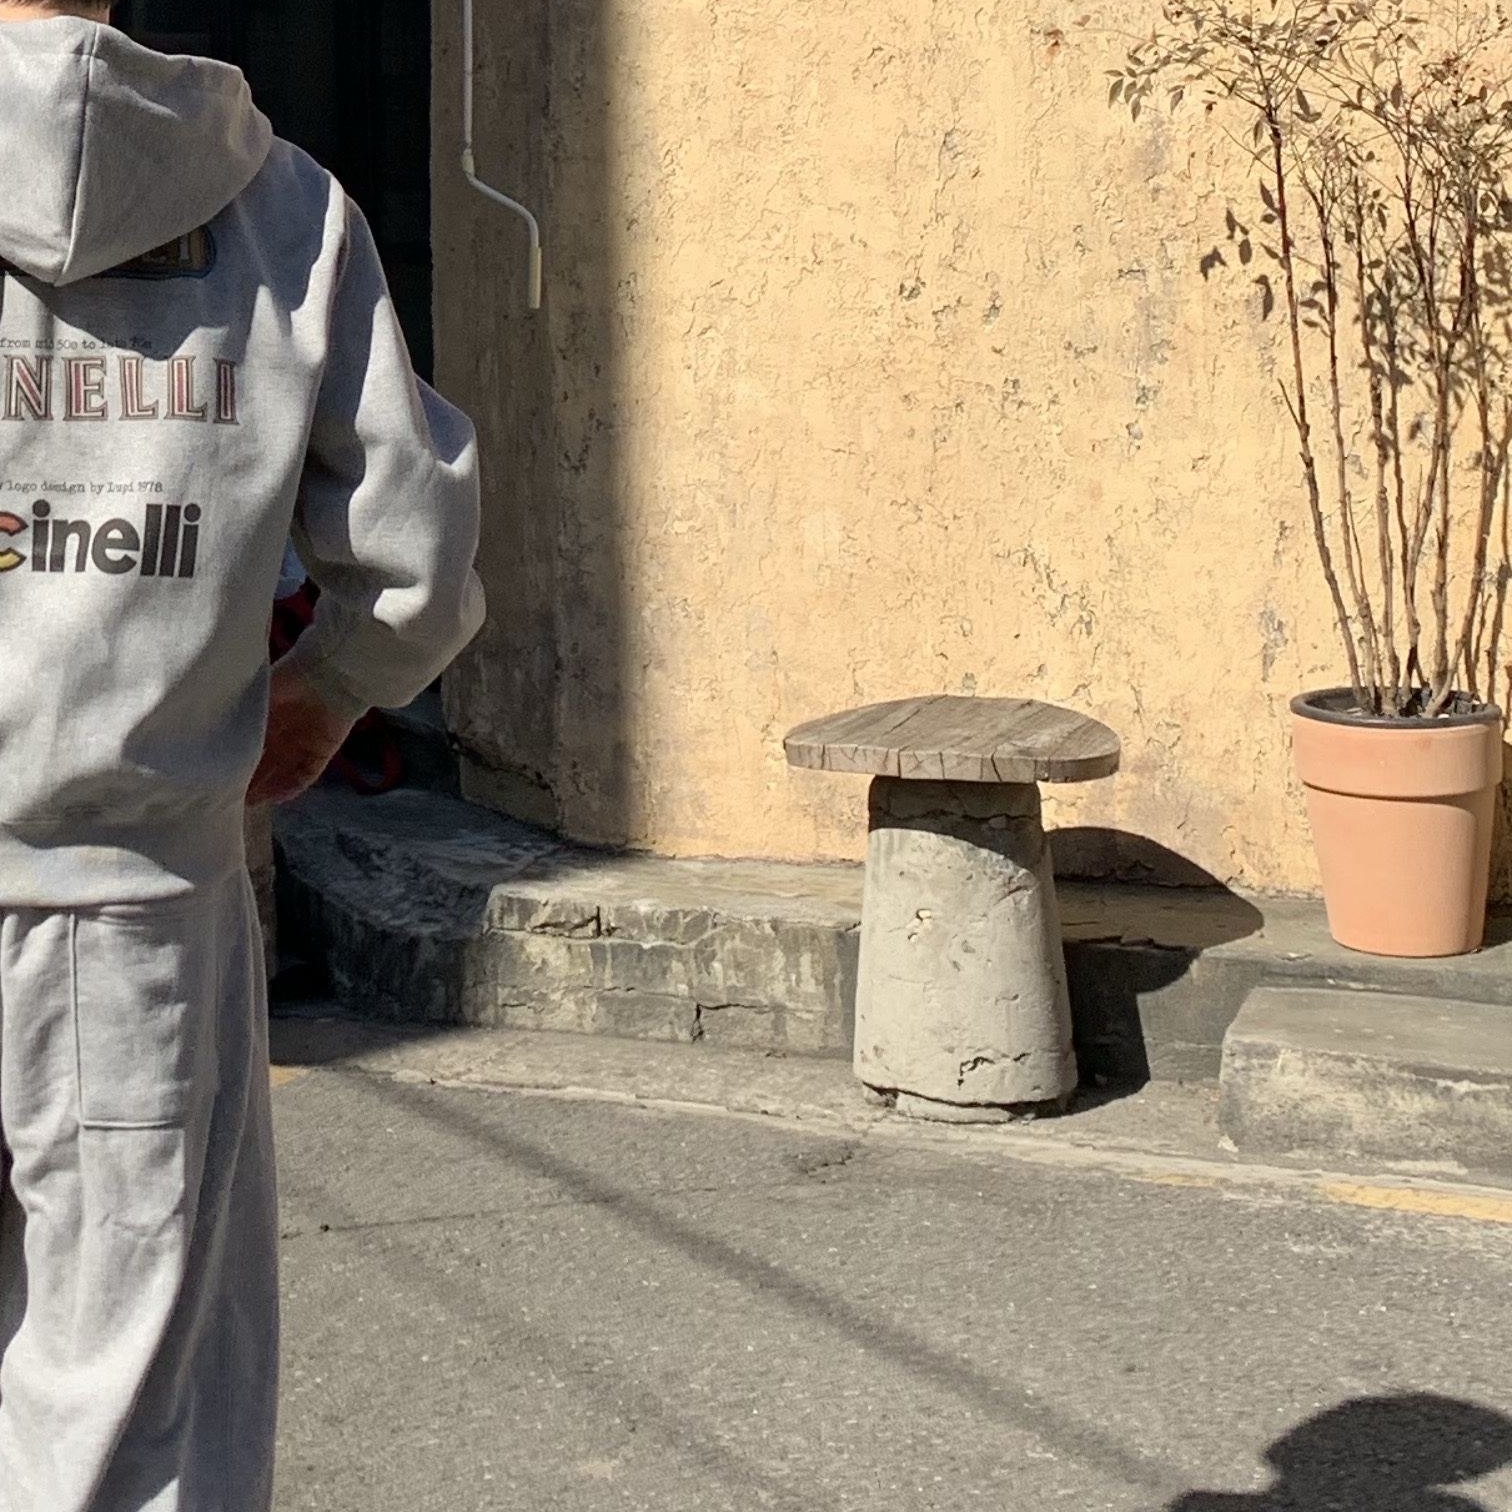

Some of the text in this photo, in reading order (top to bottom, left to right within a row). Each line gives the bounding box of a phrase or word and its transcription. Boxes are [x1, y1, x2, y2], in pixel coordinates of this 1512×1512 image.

[0, 337, 30, 348] from
[82, 338, 96, 349] to
[7, 480, 37, 494] logo
[40, 481, 85, 494] design
[89, 481, 103, 495] by
